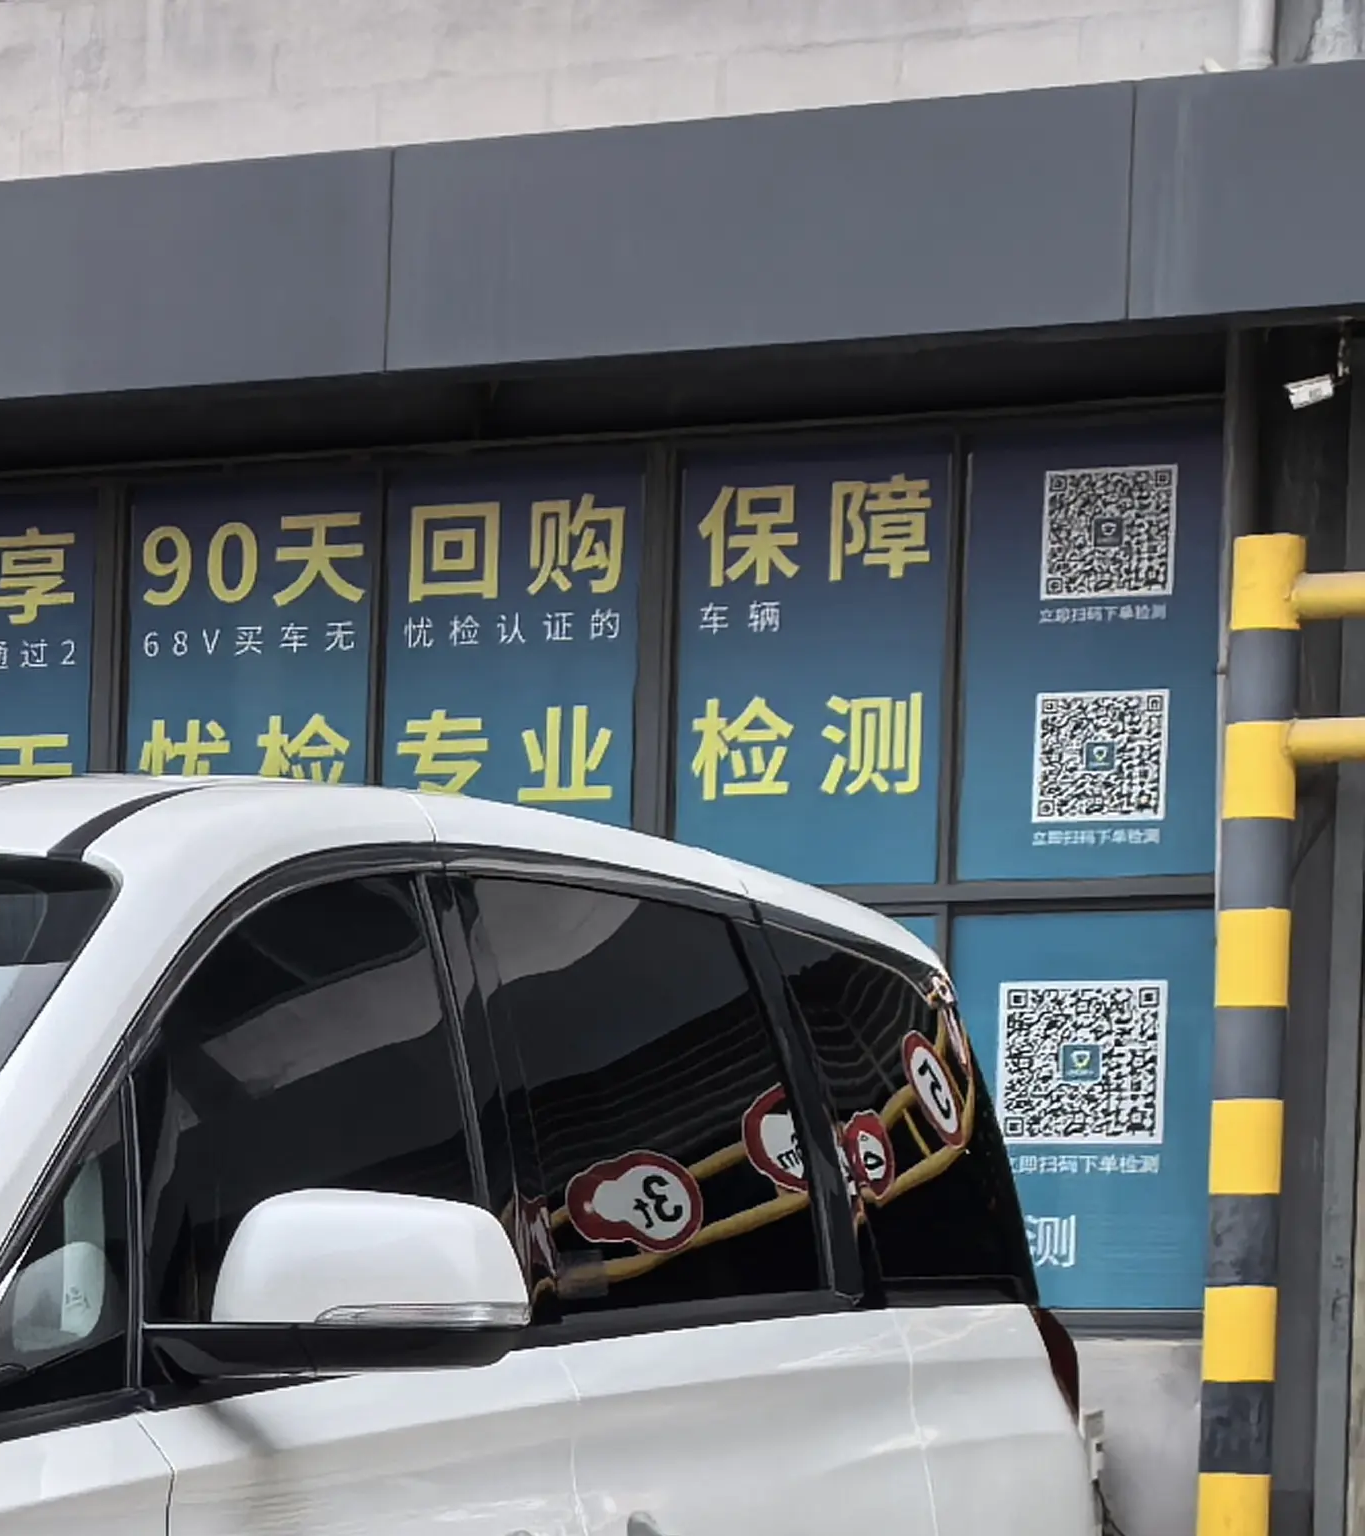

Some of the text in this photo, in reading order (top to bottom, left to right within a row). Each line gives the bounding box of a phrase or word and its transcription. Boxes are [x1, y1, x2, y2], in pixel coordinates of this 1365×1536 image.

[1038, 605, 1167, 624] 立即扫码下单检测
[1032, 828, 1161, 846] 立即扫码下单检测
